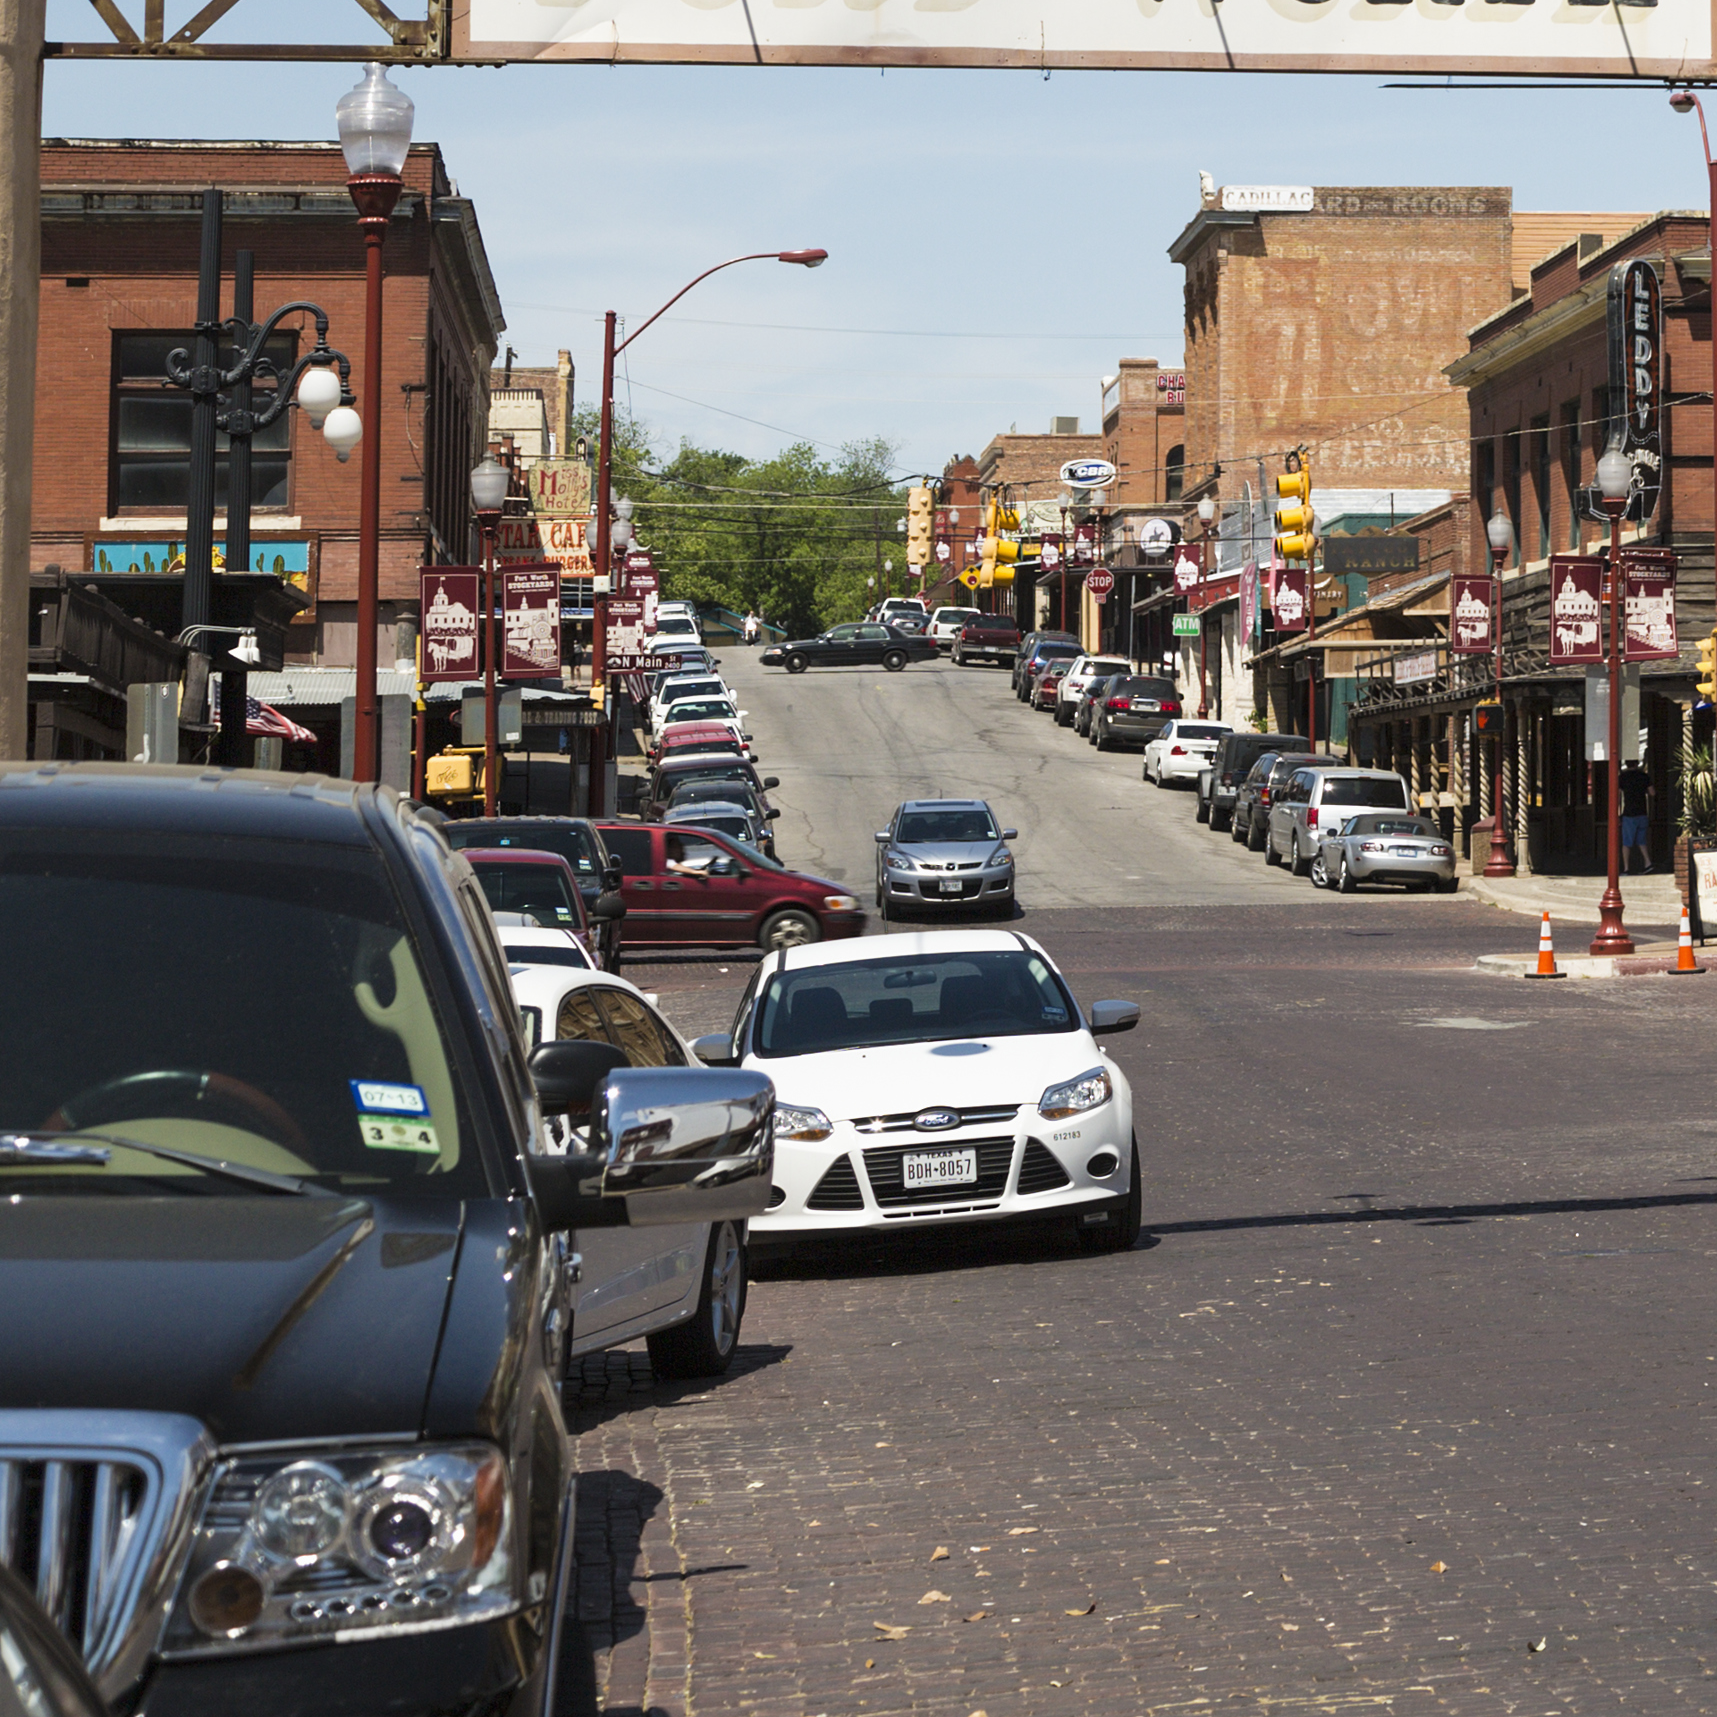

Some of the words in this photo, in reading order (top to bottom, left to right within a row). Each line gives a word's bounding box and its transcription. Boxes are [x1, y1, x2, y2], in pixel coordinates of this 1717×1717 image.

[1226, 191, 1312, 206] CADILLAC
[1393, 195, 1488, 215] ROOMS
[508, 580, 555, 590] STOCKYARDS
[1088, 576, 1112, 588] STOP
[1175, 617, 1199, 630] ATM
[622, 656, 630, 668] N
[636, 655, 662, 668] Main
[579, 711, 598, 724] POST
[1053, 1130, 1081, 1141] 612183
[926, 1150, 953, 1159] TEXAS
